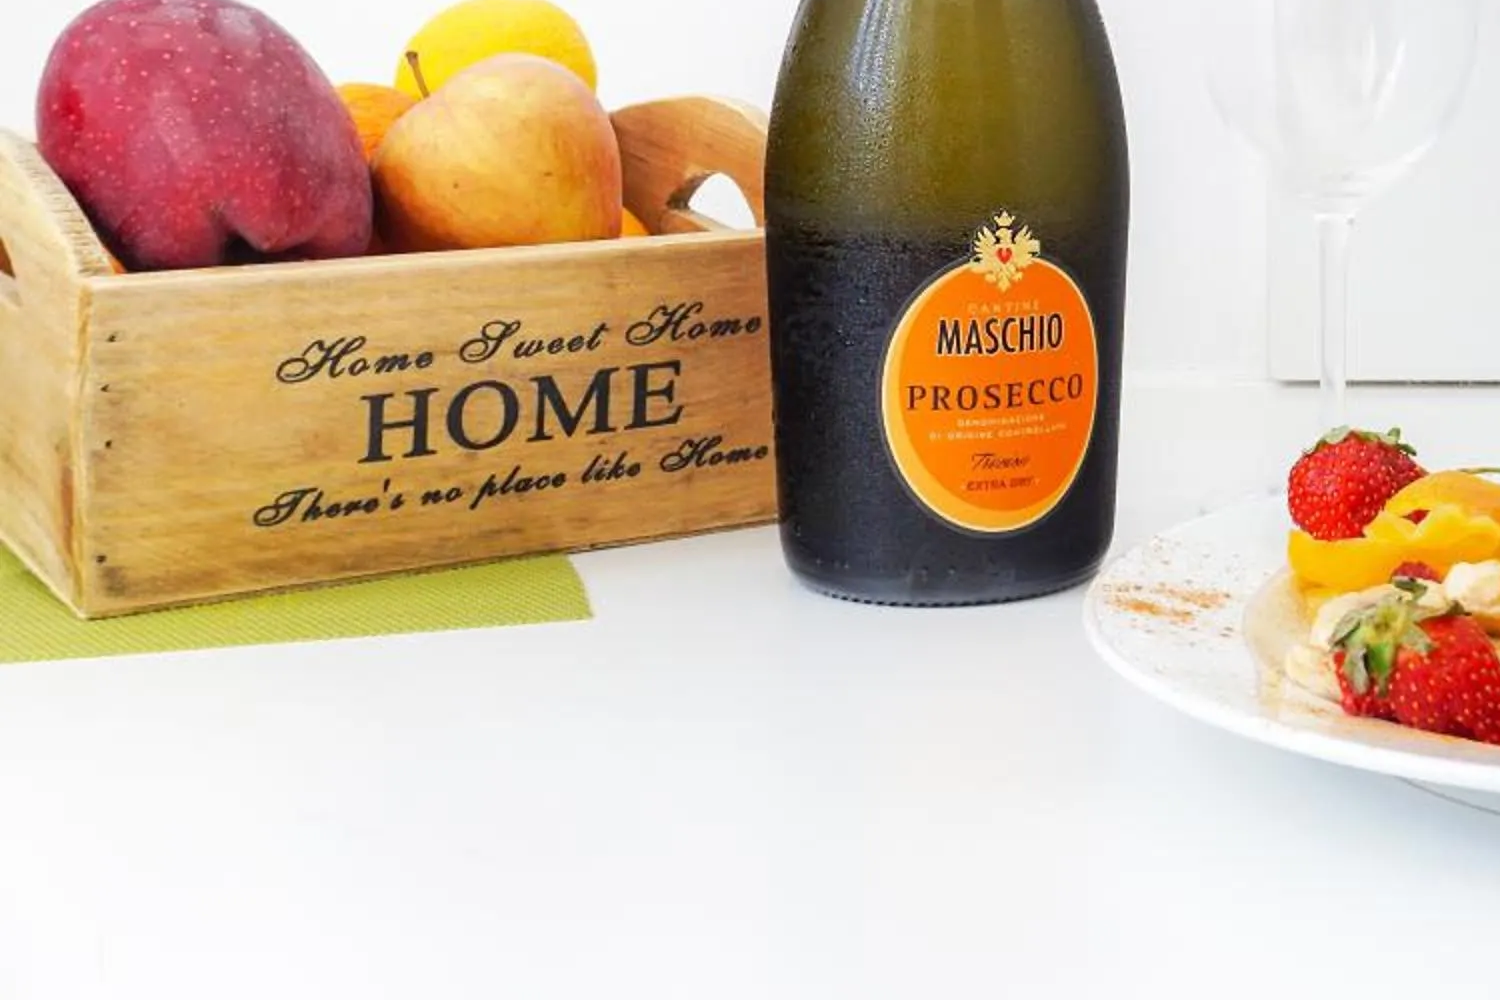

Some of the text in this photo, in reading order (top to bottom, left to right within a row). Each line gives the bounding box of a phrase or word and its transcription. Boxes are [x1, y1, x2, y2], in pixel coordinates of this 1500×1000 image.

[275, 301, 762, 383] Home Sweet Home
[936, 312, 1064, 355] MASCHIO
[357, 359, 685, 463] HOME
[906, 372, 1084, 411] PROSECCO
[253, 434, 769, 527] There's no place like Home
